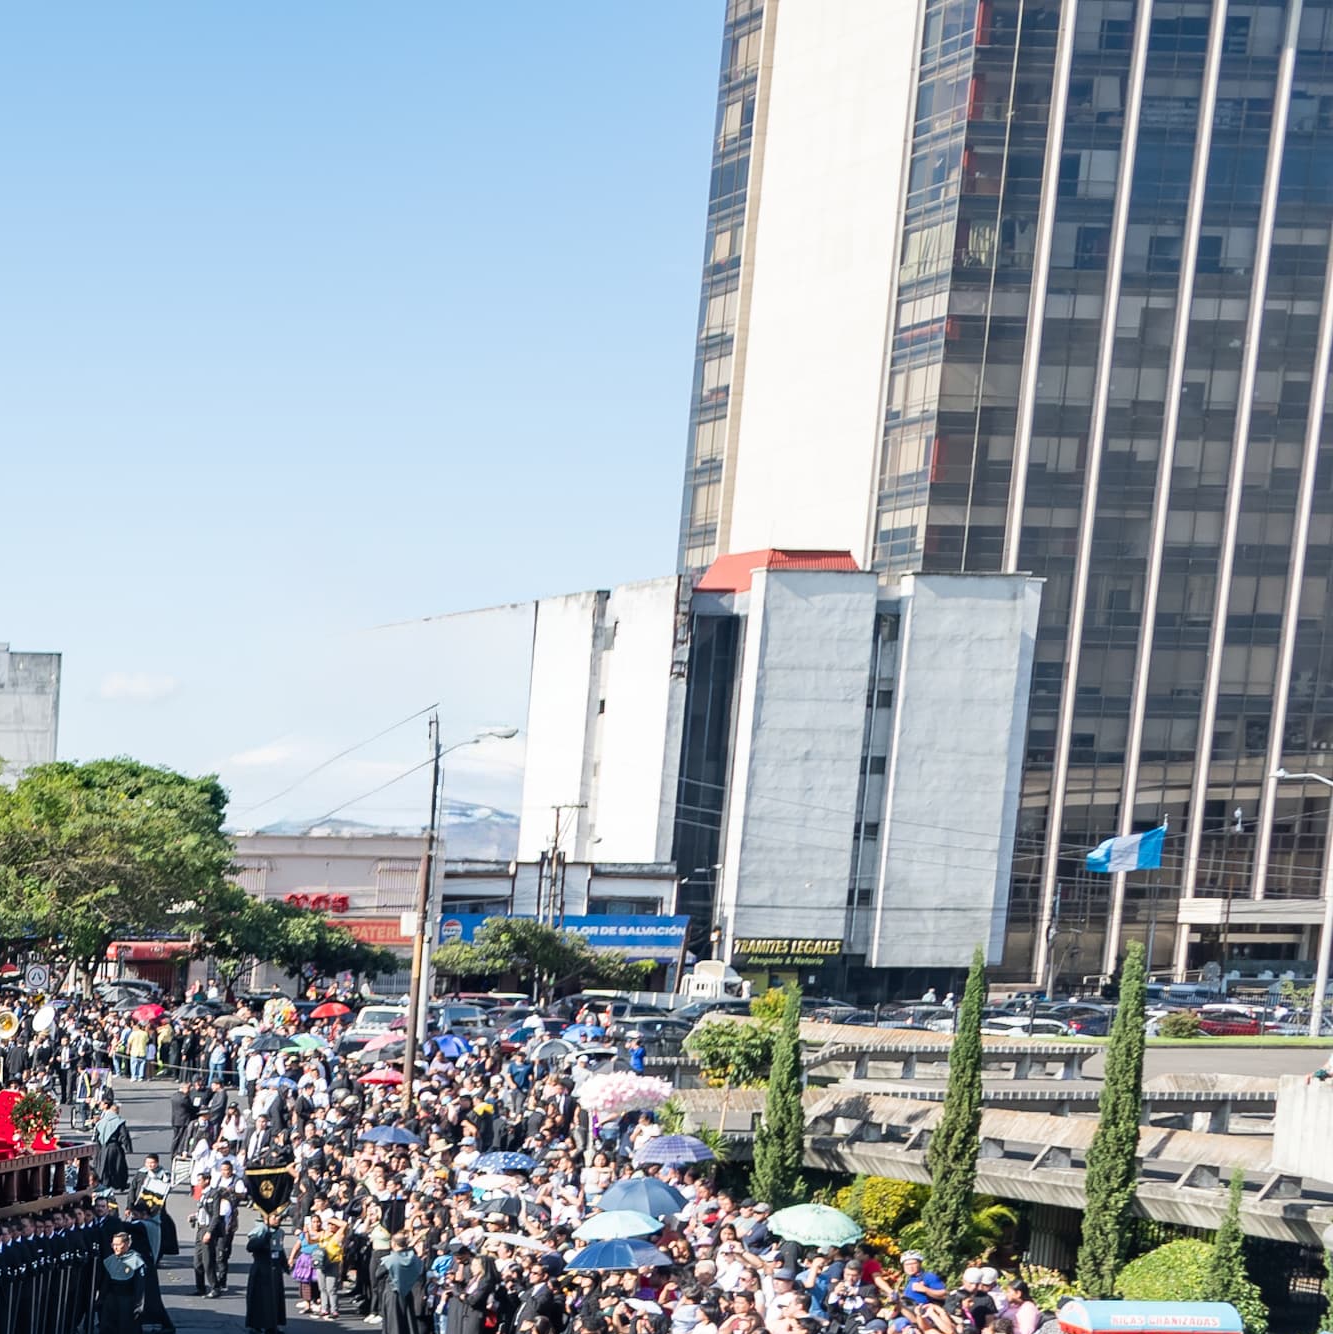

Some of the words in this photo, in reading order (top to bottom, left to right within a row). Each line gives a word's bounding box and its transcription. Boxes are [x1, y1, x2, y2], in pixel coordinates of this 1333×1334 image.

[352, 926, 400, 939] PATERI
[599, 926, 618, 936] DE
[618, 923, 686, 936] SALVACIÓN
[790, 940, 842, 954] LEGALES
